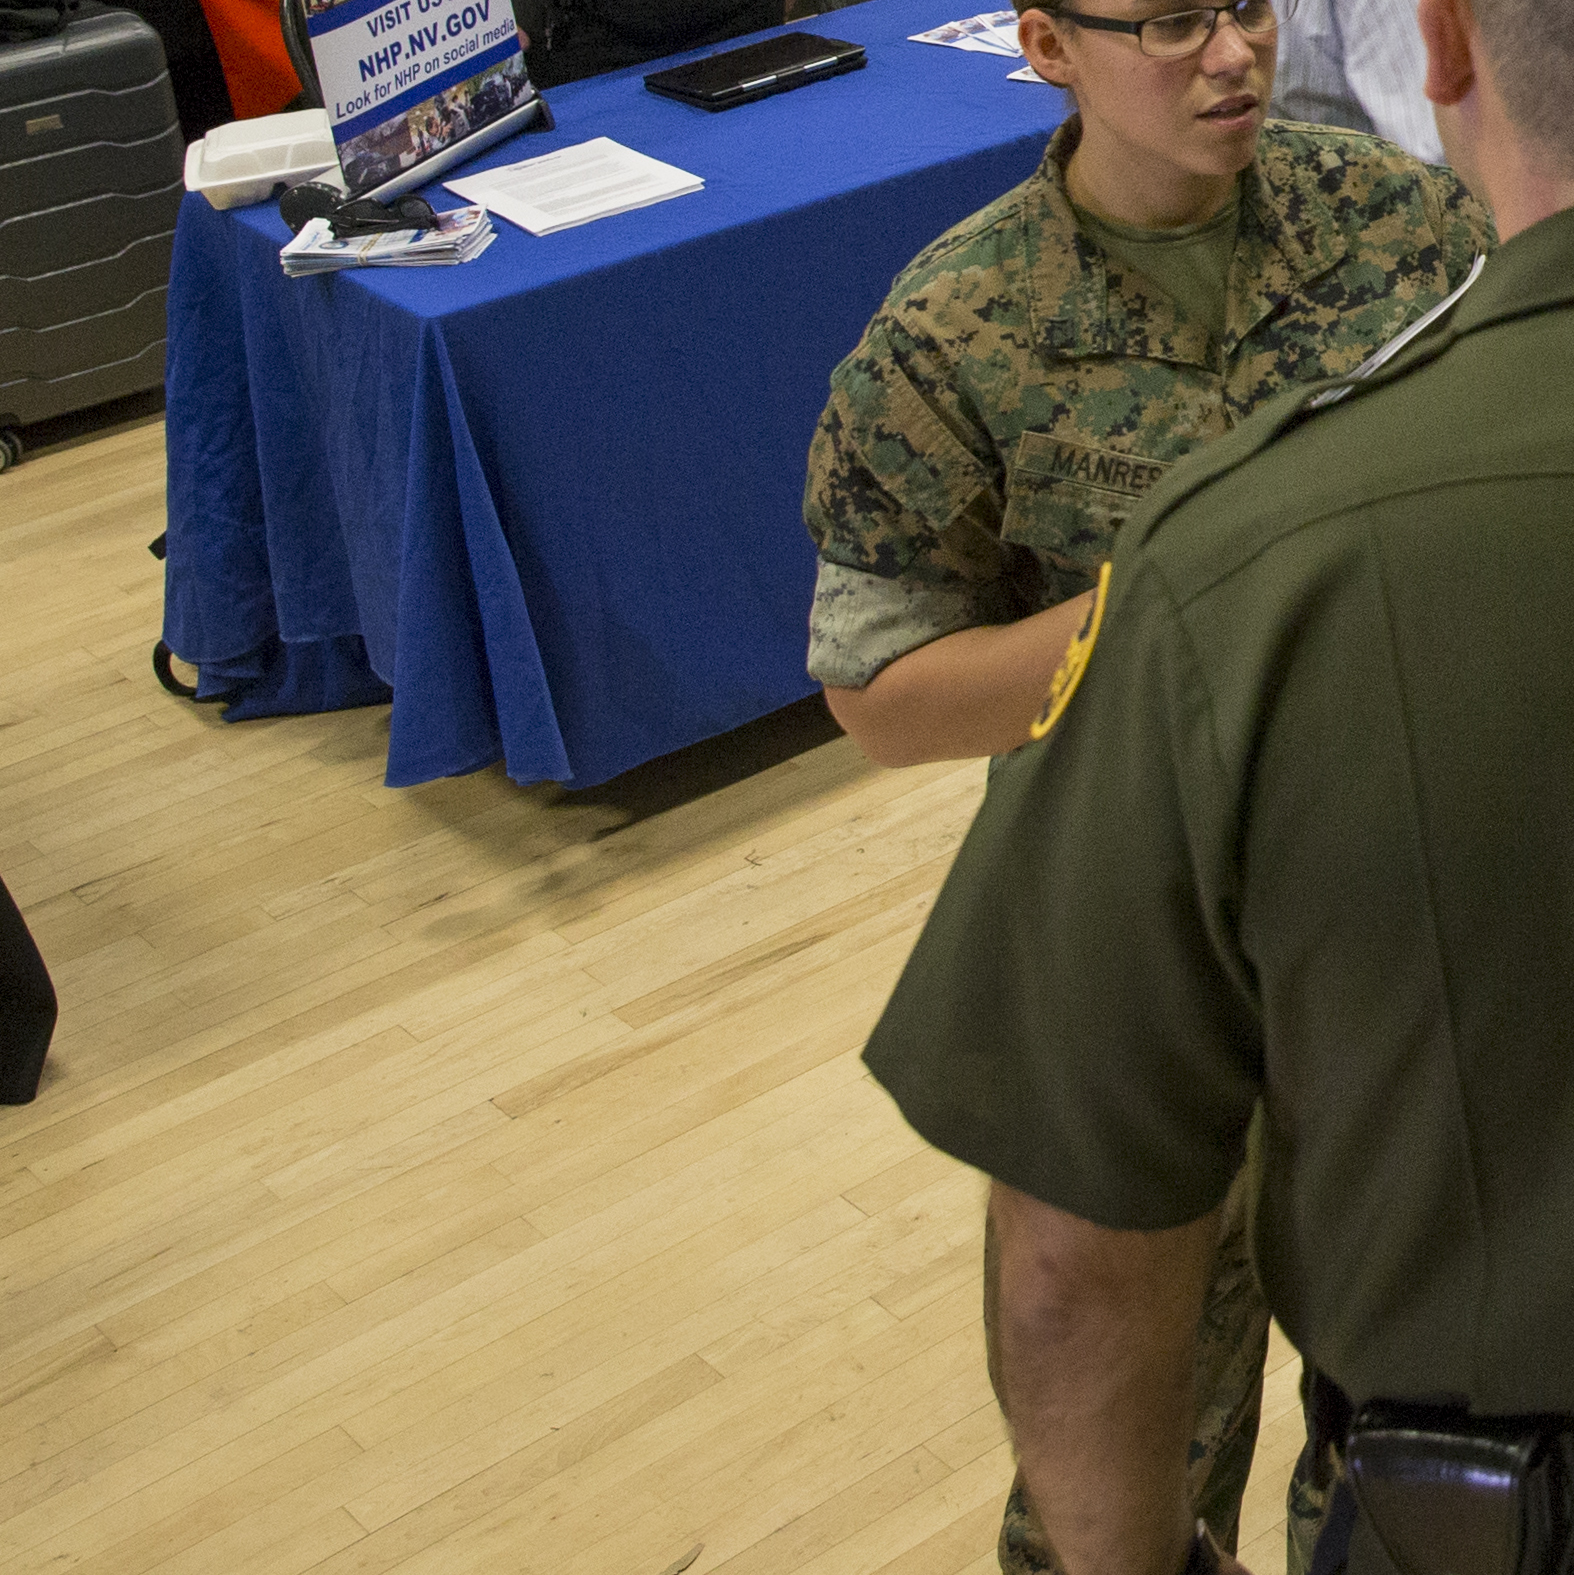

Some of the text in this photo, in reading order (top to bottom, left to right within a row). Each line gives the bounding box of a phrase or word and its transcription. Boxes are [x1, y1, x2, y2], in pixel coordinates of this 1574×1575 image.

[366, 1, 411, 38] VISIT
[335, 17, 516, 119] Look for NHP on social media
